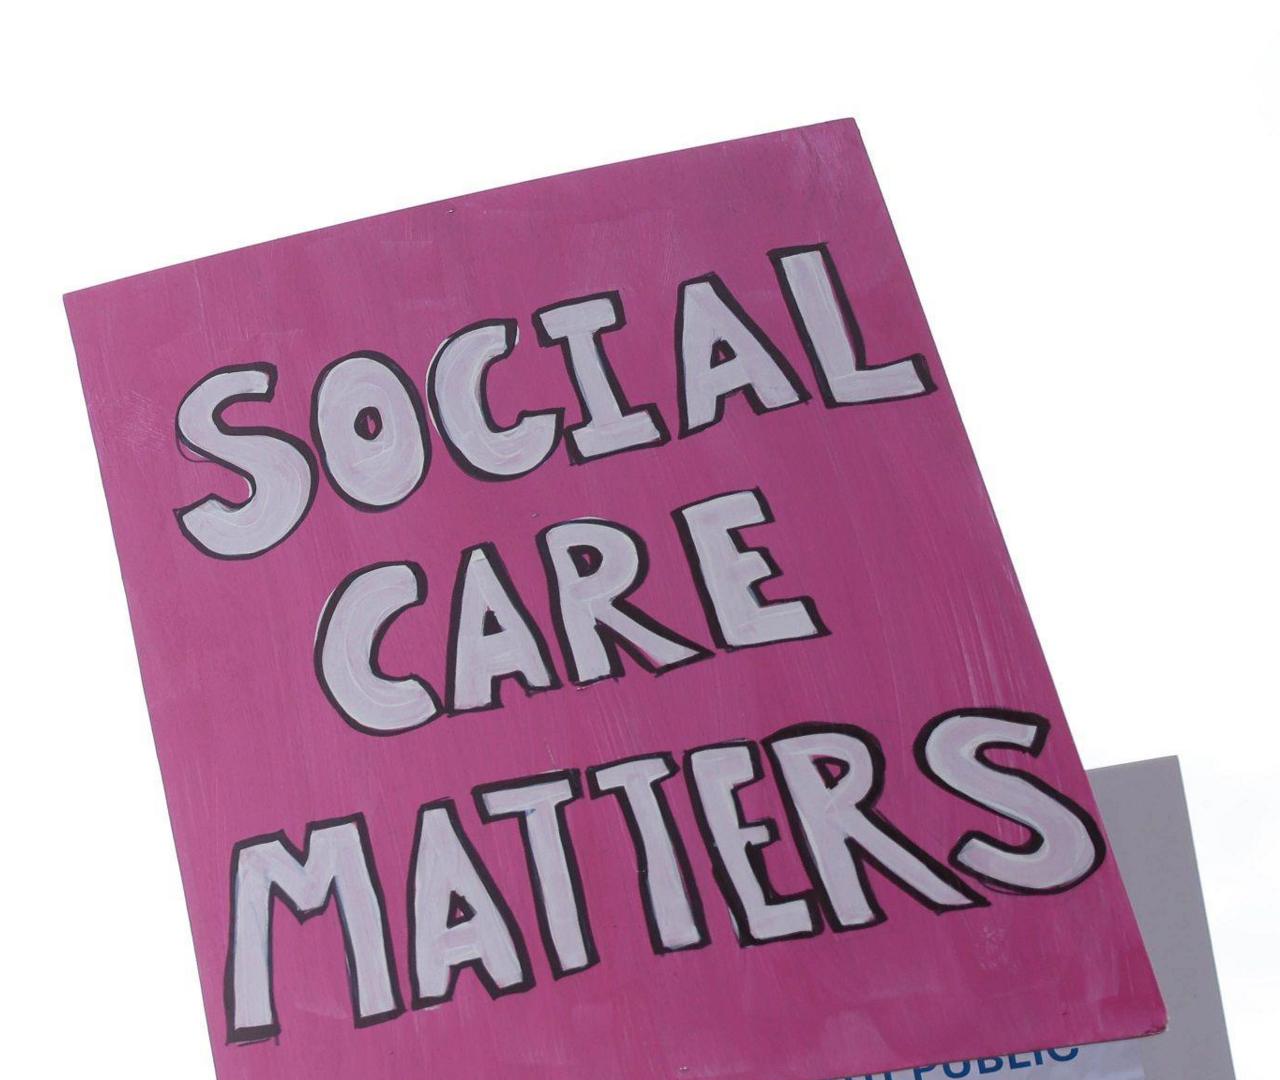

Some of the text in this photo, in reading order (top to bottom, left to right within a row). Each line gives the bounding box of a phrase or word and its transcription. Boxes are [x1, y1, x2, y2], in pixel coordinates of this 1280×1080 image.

[175, 242, 938, 560] SOCIAL
[313, 486, 831, 736] CARE
[225, 707, 1106, 1045] MATTERS
